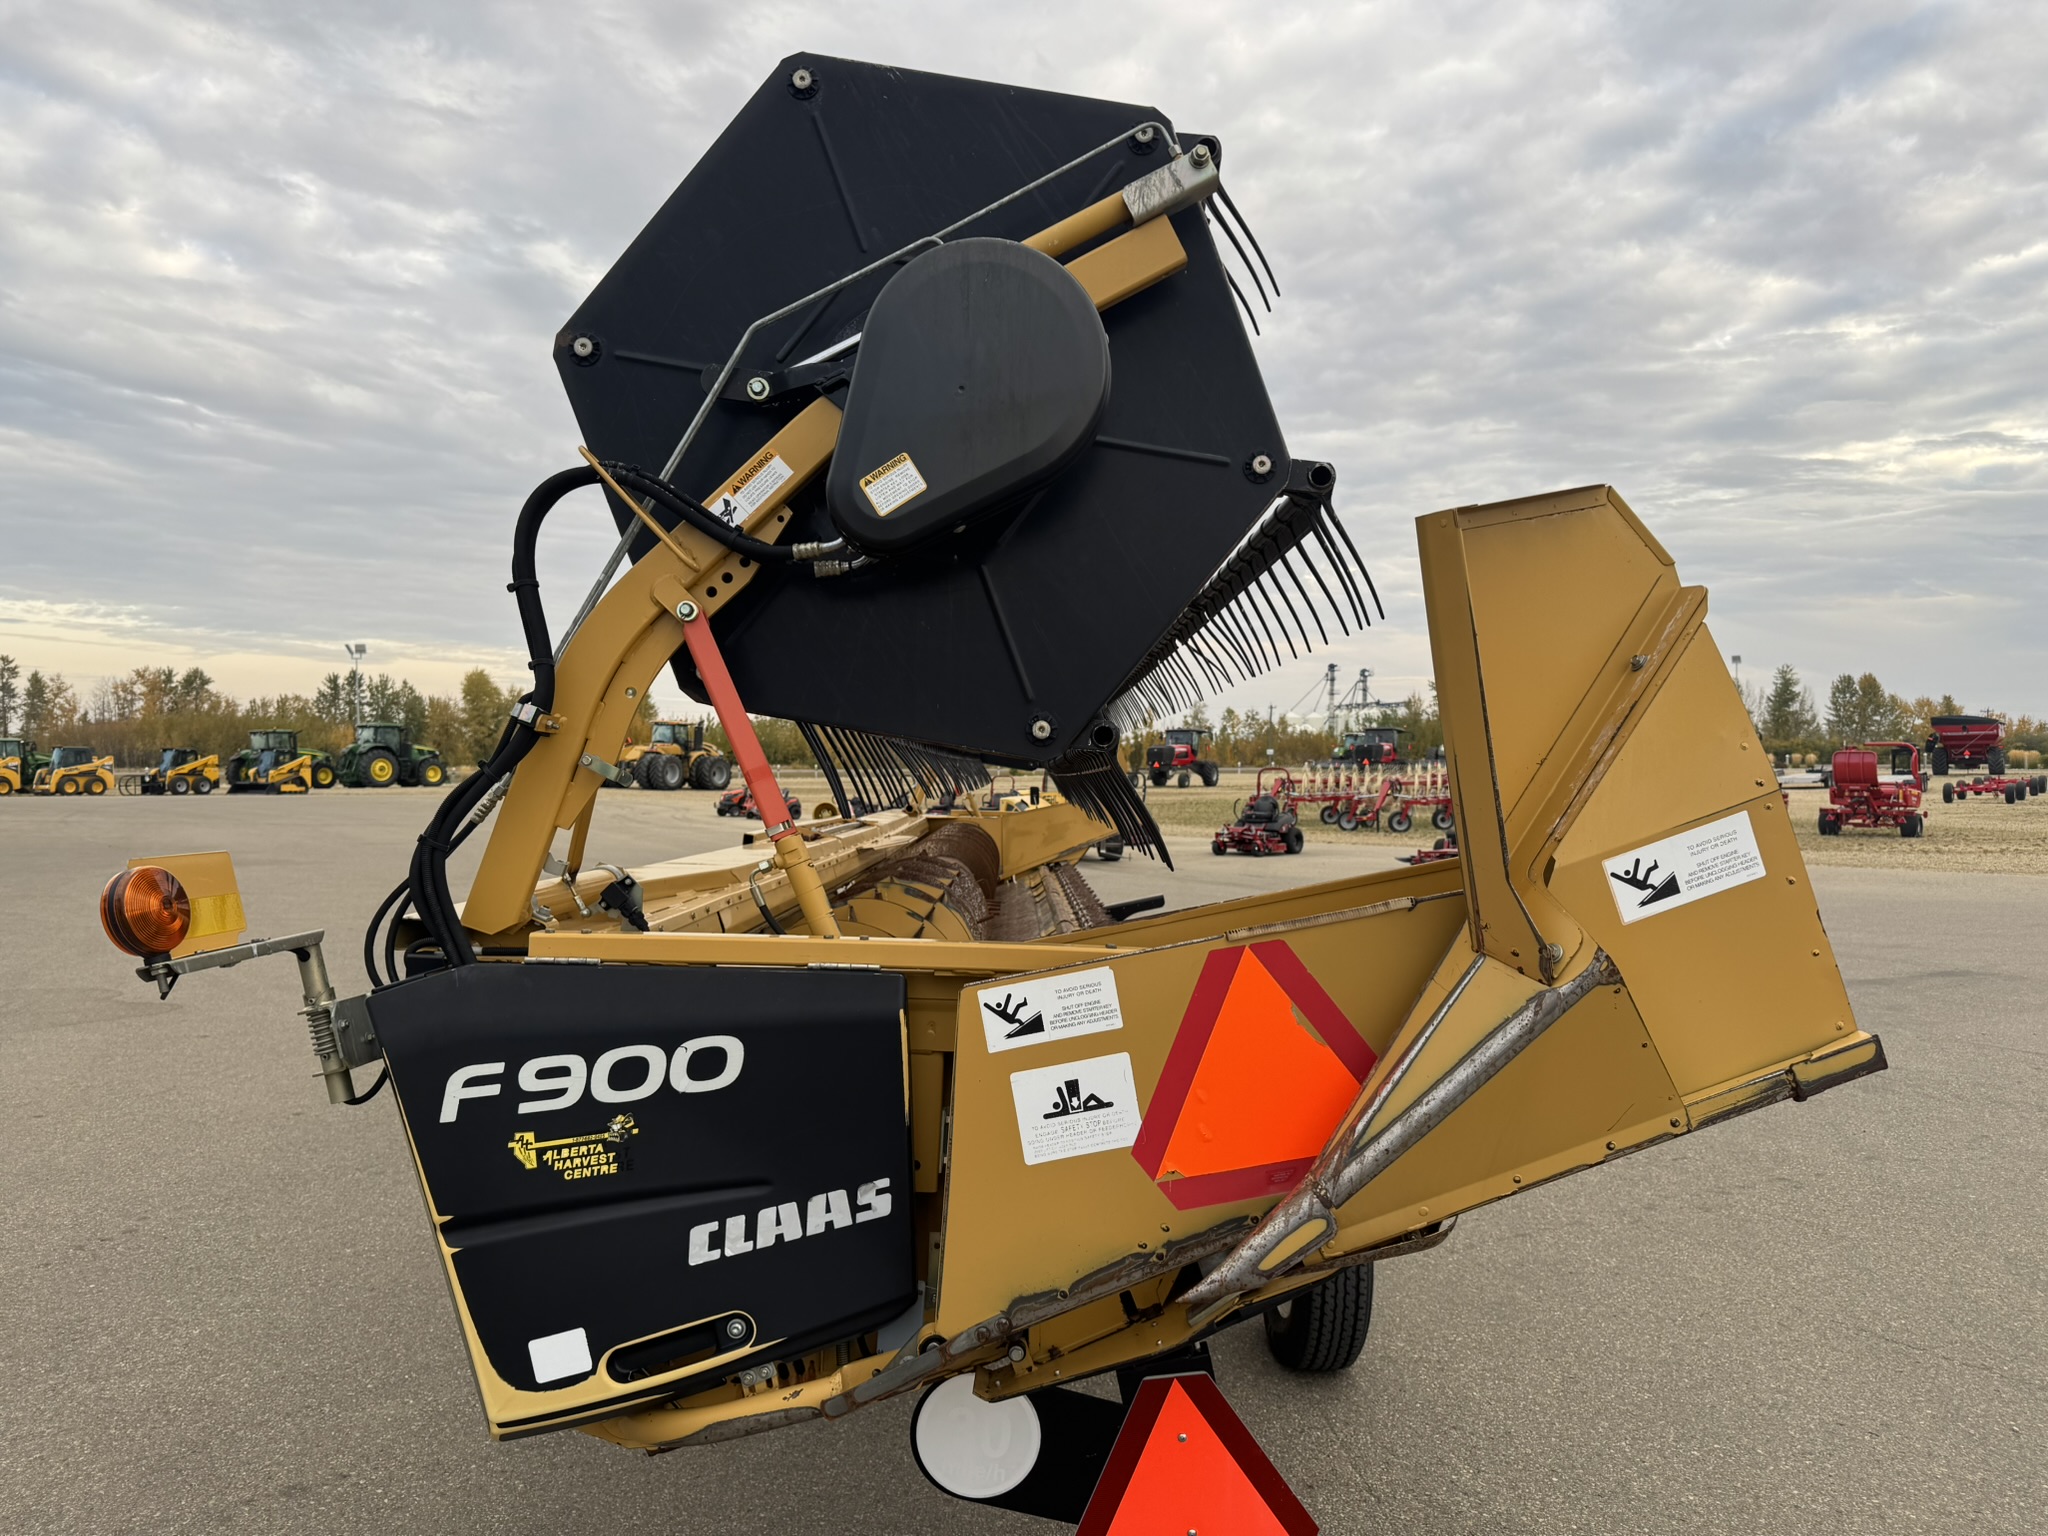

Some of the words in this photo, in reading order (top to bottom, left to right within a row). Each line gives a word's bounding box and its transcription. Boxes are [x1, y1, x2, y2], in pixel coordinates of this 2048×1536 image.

[737, 452, 774, 485] WARNING
[870, 454, 906, 480] WARNING
[1690, 846, 1709, 856] INJURY
[1720, 836, 1737, 846] DEATH
[1696, 838, 1712, 847] AVOID
[1713, 829, 1737, 841] SERIOUS
[1720, 849, 1737, 859] ENGINE
[1685, 874, 1704, 884] BEFORE
[1705, 863, 1737, 878] UNCLOGGING
[1738, 856, 1758, 866] HEADER
[1699, 863, 1718, 873] REMOVE
[1720, 855, 1740, 865] STARTER
[1695, 877, 1714, 887] MAKING
[1725, 862, 1759, 876] ADJUSTMENTS
[1079, 981, 1101, 989] SERIOUS
[1086, 1014, 1118, 1023] ADJUSTMENTS
[1085, 1120, 1101, 1128] STOP
[542, 1143, 604, 1166] ALBERTA
[554, 1152, 616, 1170] HARVEST
[564, 1163, 618, 1180] CENTRE
[688, 1178, 892, 1266] CLAAS
